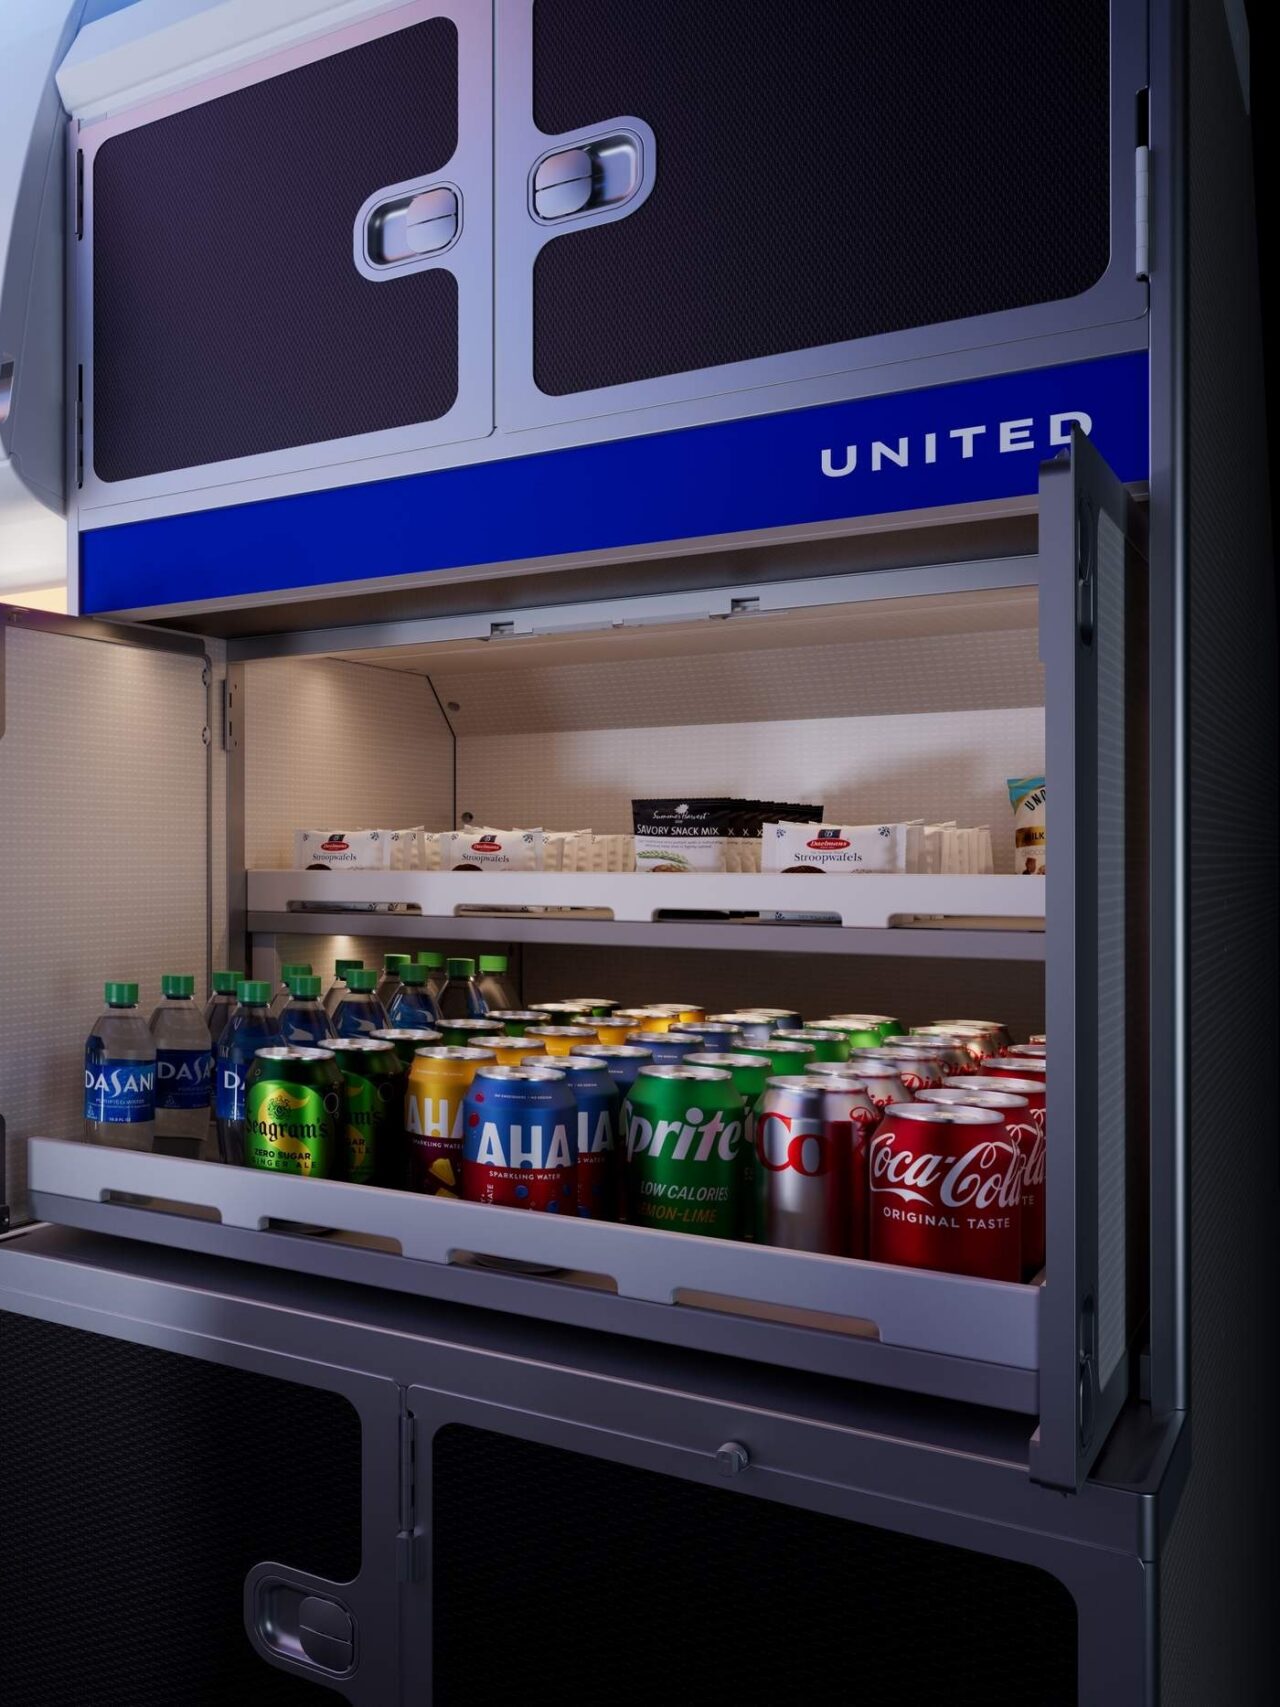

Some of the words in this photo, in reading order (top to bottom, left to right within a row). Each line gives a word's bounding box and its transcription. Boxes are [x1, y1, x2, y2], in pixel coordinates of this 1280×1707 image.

[821, 411, 1092, 478] UNITED
[637, 824, 669, 835] SAVORY
[671, 826, 700, 836] SNACK
[701, 827, 719, 836] MIX
[461, 853, 510, 864] Stroopwafels
[794, 852, 863, 864] Stroopwafels
[157, 1056, 212, 1086] DASA
[85, 1068, 154, 1098] DASANI
[870, 1094, 893, 1107] iet
[345, 1138, 365, 1146] GAR
[476, 1122, 573, 1169] AHA
[255, 1148, 275, 1159] ZERO
[277, 1151, 311, 1160] SUGAR
[296, 1160, 319, 1170] ALE
[870, 1133, 1022, 1210] Coca-Cola
[489, 1170, 535, 1181] SPARKLING
[536, 1172, 561, 1181] WATER
[641, 1180, 667, 1198] LOW
[668, 1185, 729, 1202] CALORIES
[639, 1201, 718, 1224] EMON-LIME
[883, 1206, 960, 1229] ORIGINAL
[967, 1217, 1010, 1230] TASTE
